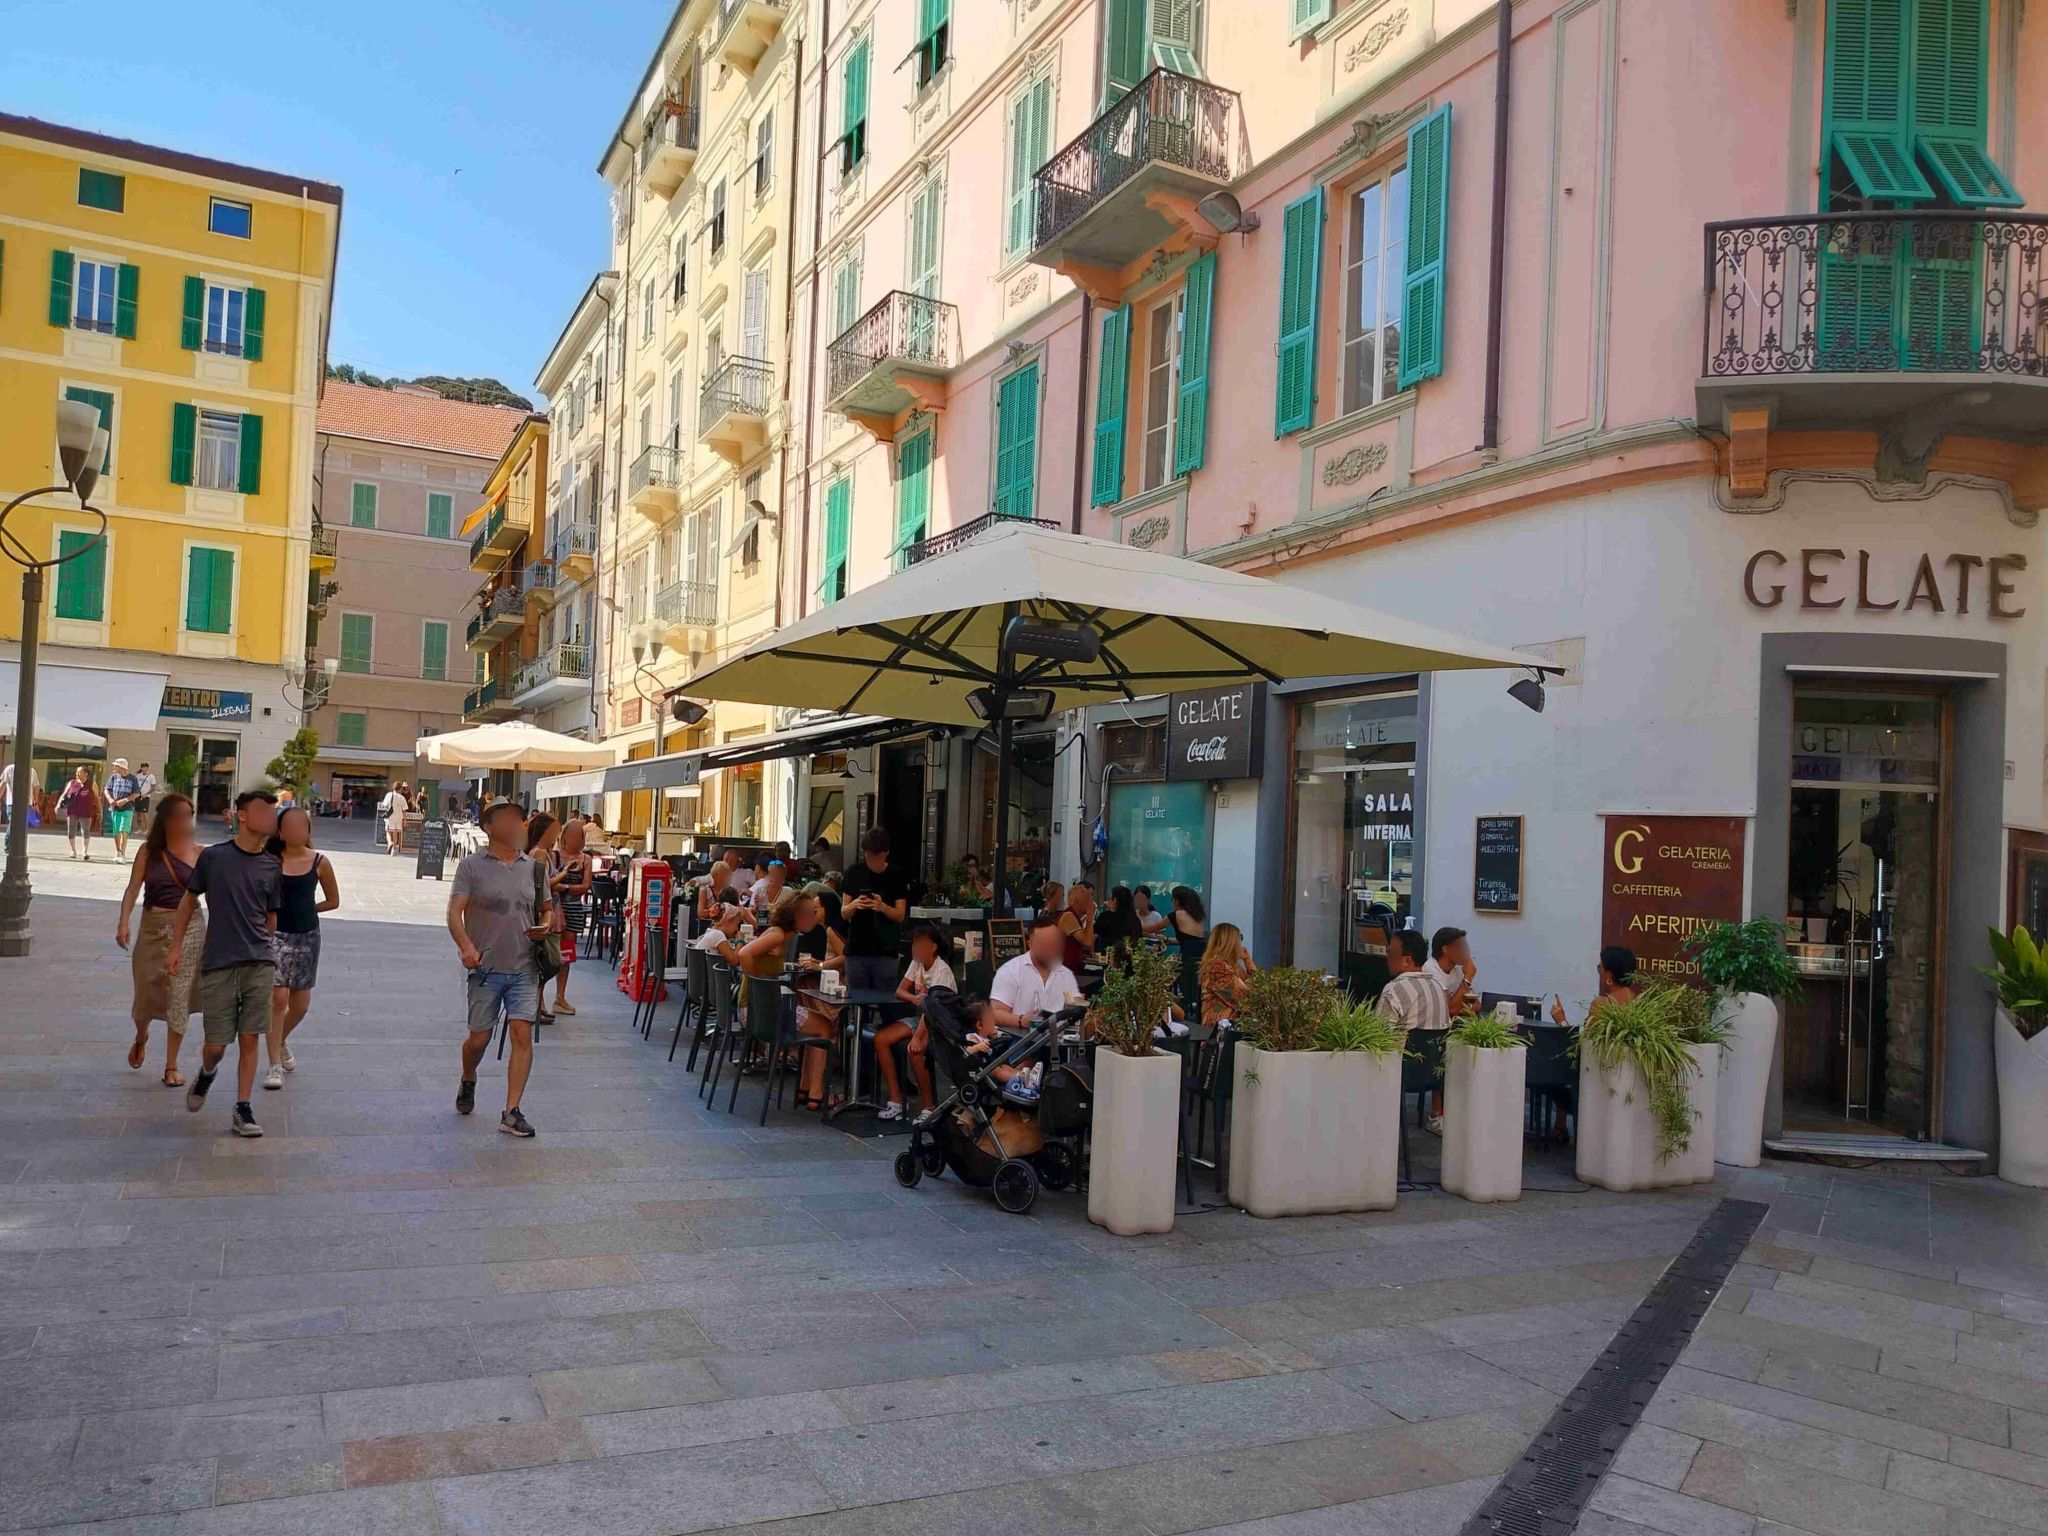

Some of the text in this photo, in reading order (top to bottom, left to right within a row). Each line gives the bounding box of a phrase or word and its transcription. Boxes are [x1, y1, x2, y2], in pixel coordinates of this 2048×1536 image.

[163, 686, 221, 708] TEATRO
[211, 704, 251, 719] ILLEGALE
[1364, 793, 1412, 812] SALA
[1363, 825, 1411, 840] INTERNA
[1658, 845, 1732, 860] GELATERIA
[1691, 860, 1732, 870] CREMERIA
[1612, 883, 1682, 897] CAFFETTERIA
[1651, 958, 1700, 975] FREDDI
